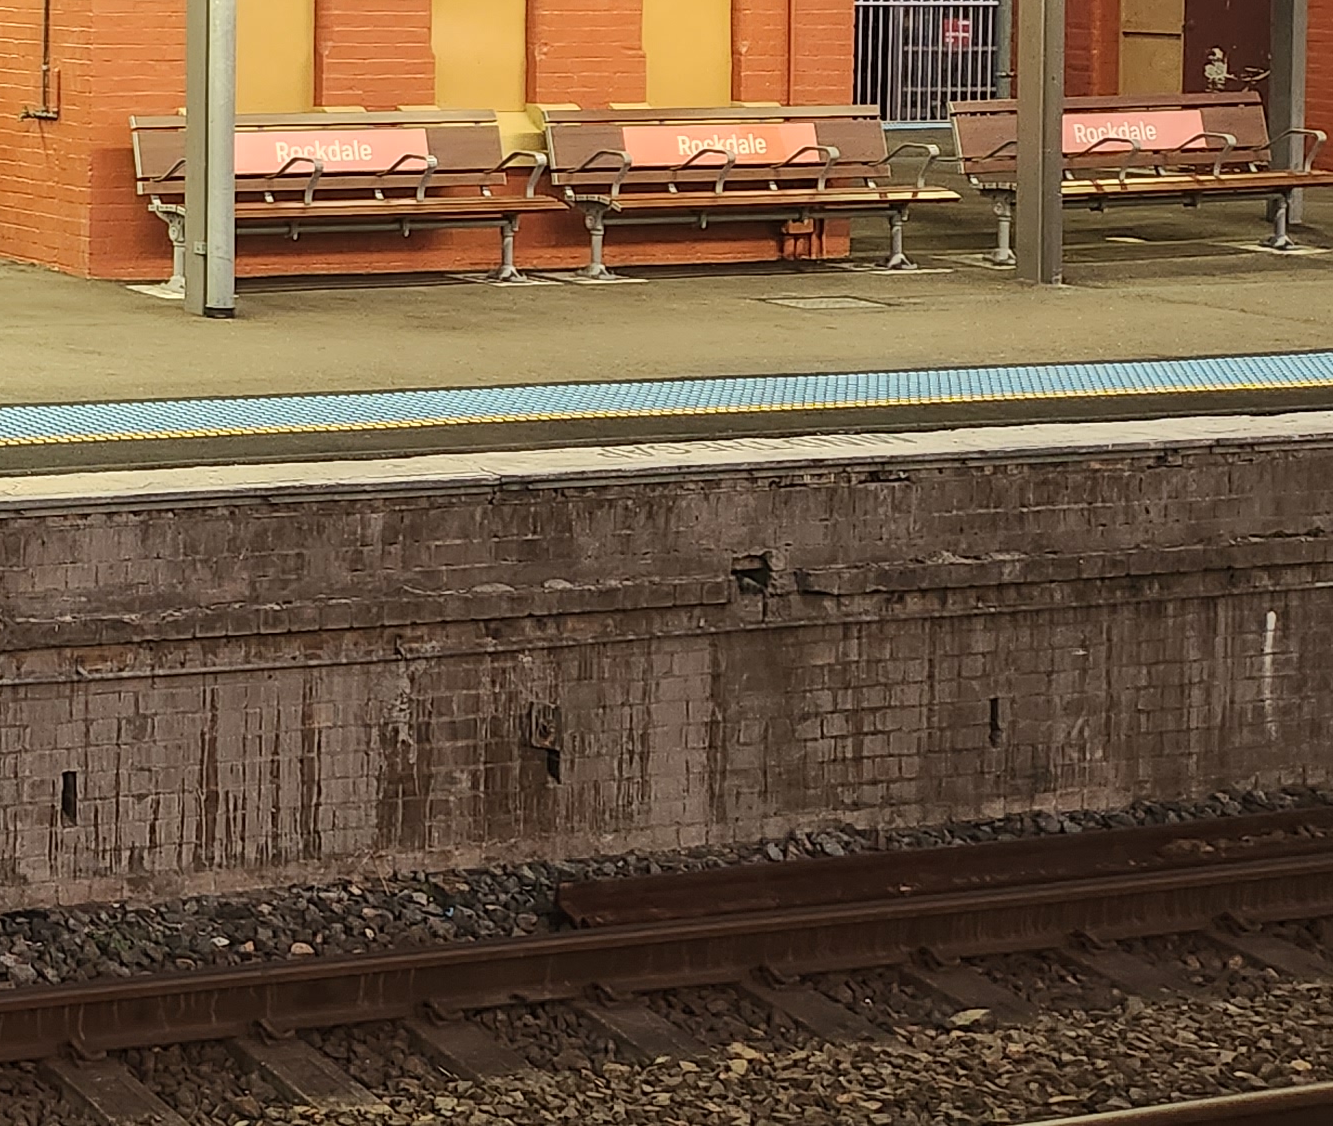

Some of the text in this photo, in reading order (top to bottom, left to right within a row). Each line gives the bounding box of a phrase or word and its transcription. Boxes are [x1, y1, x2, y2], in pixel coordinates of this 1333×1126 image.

[1073, 120, 1157, 143] Rockdale
[275, 139, 372, 162] Rockdale
[597, 445, 692, 459] GAP
